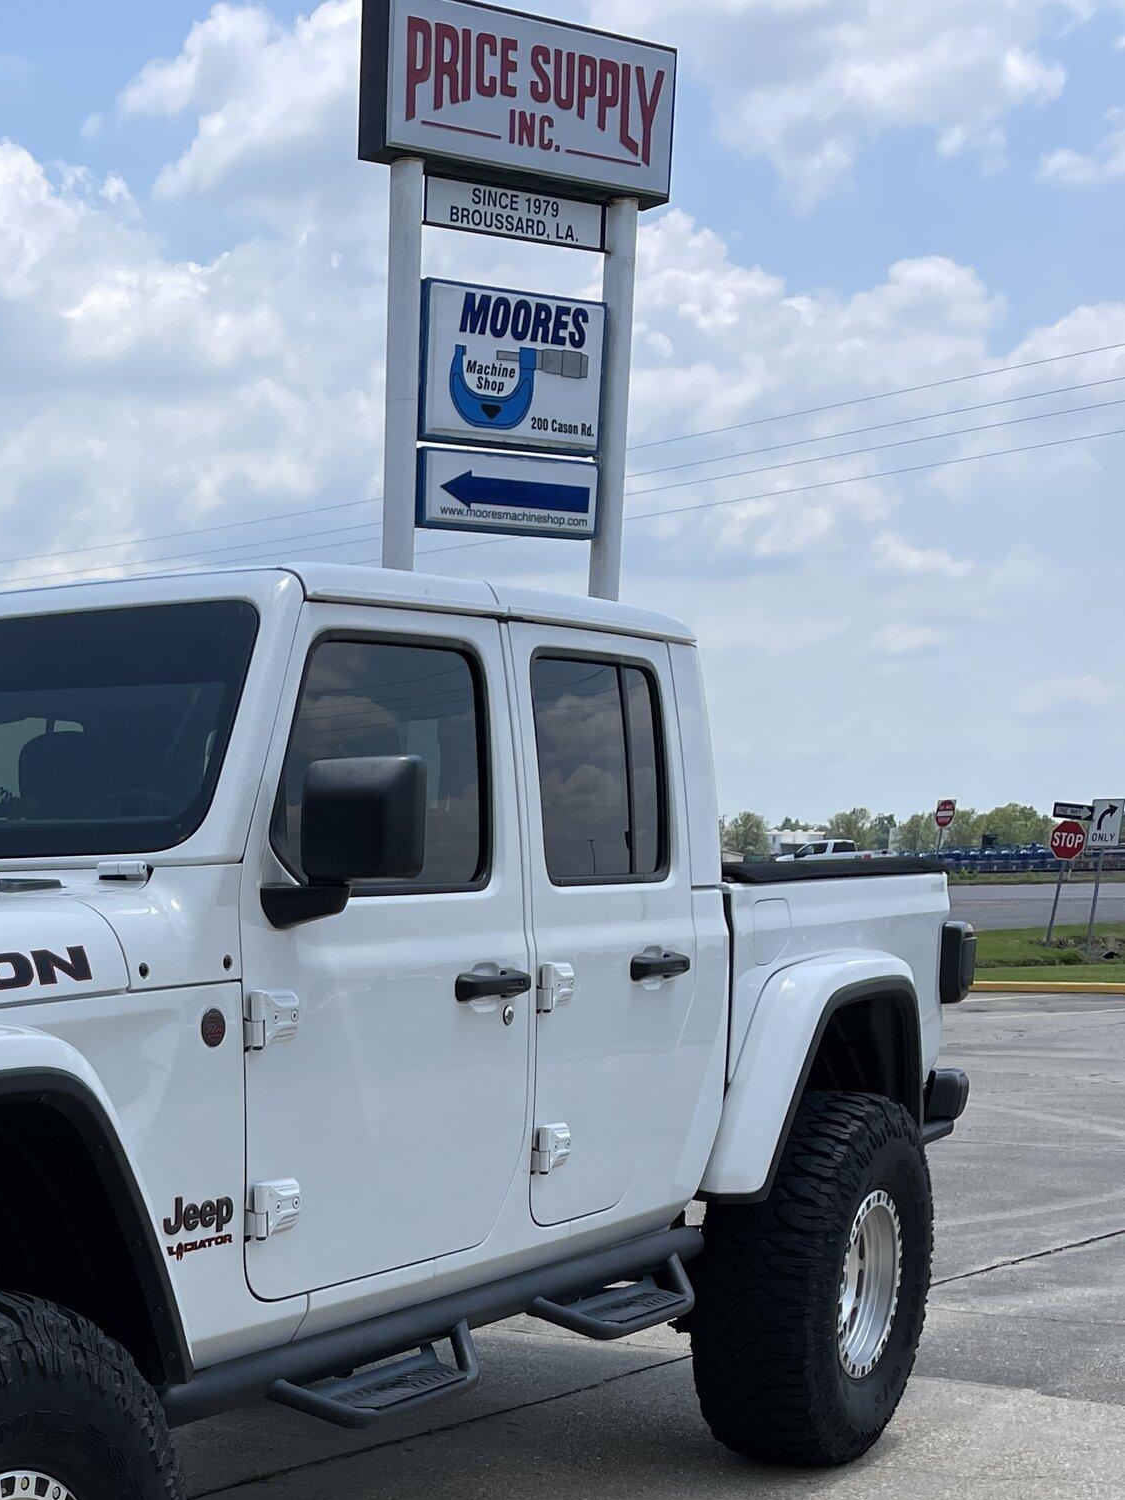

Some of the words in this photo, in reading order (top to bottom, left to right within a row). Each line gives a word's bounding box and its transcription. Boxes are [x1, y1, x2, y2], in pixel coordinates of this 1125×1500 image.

[405, 15, 518, 122] PRICE
[529, 44, 665, 168] SUPPLY
[508, 109, 560, 153] INC.
[471, 187, 519, 212] SINCE
[525, 196, 559, 218] 1979
[449, 205, 551, 239] BROUSSARD,
[555, 221, 579, 243] LA.
[459, 291, 589, 349] MOORES
[466, 359, 516, 379] Machine
[476, 376, 504, 395] Shop
[531, 416, 549, 432] 200
[551, 419, 578, 436] Cason
[580, 422, 595, 438] Rd.
[439, 504, 588, 528] www.mooresmachineshop.com
[1052, 832, 1084, 849] STOP
[1091, 832, 1115, 843] ONLY
[163, 1196, 234, 1236] Jeep
